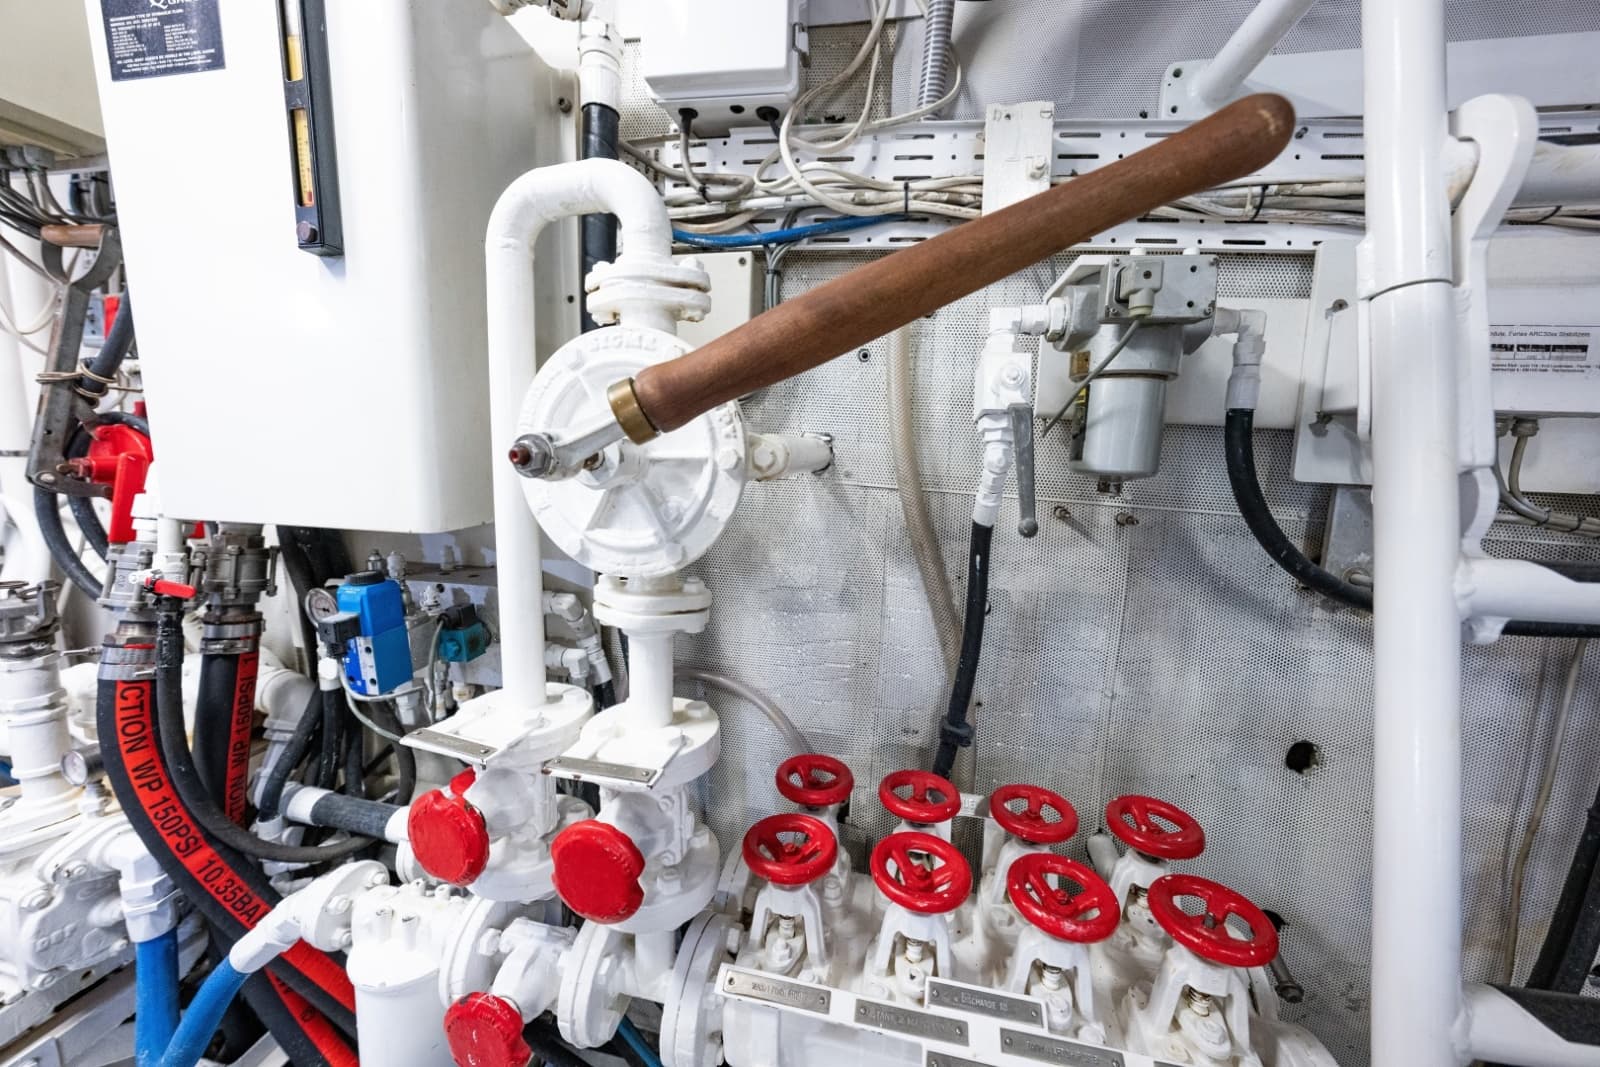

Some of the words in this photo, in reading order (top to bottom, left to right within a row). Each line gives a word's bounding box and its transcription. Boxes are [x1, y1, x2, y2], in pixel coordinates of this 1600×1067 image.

[120, 679, 151, 754] CTION
[235, 676, 256, 736] 150PSI
[131, 757, 164, 793] WP
[149, 796, 203, 859] 150PSI
